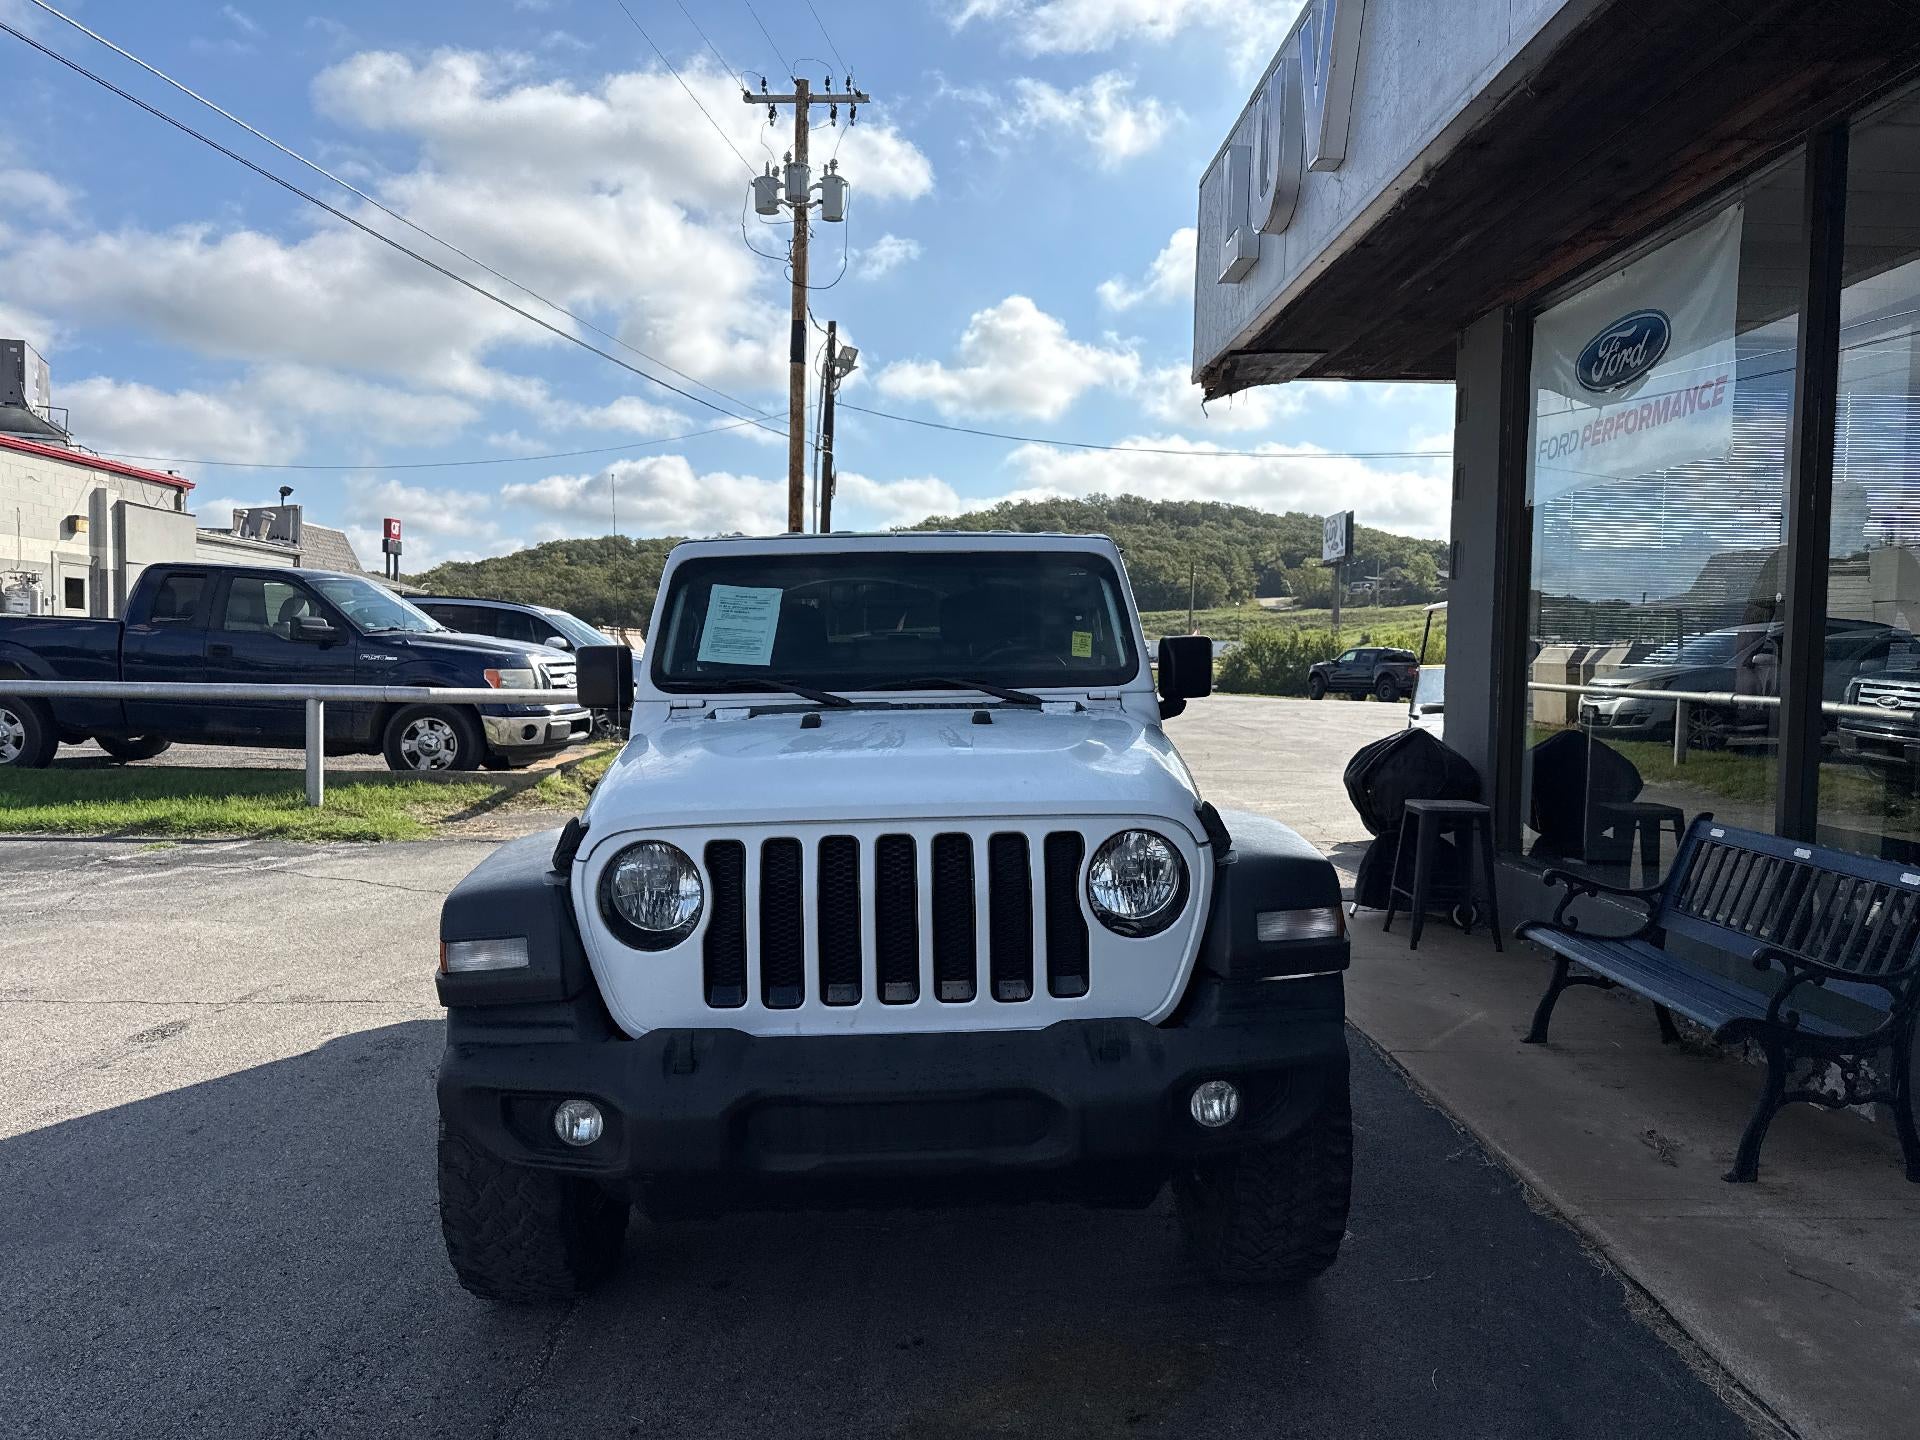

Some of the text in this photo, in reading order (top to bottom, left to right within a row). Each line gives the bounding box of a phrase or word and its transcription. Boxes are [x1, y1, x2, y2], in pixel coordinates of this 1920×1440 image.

[1591, 324, 1651, 383] Ford
[1537, 374, 1729, 463] FORD PERFORMANCE
